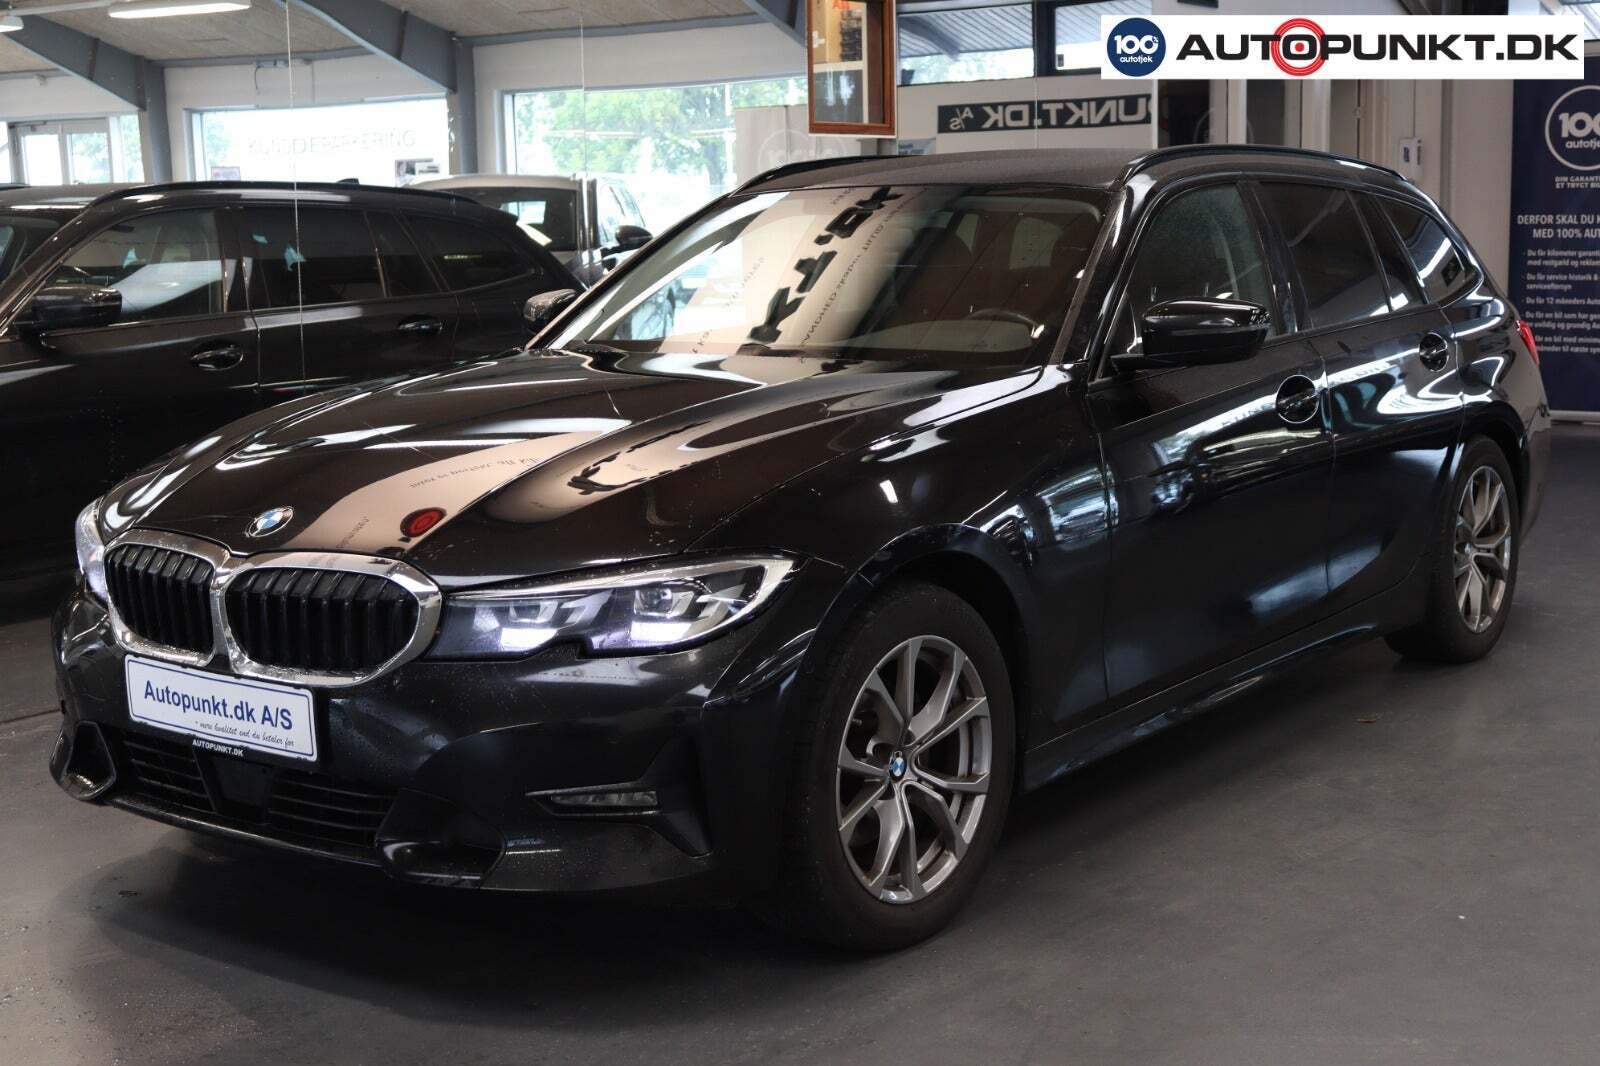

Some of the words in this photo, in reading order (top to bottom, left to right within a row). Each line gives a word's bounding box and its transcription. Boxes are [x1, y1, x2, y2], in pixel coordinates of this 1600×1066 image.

[1517, 214, 1554, 225] DERFOR
[1555, 214, 1579, 225] SKAL
[1580, 214, 1595, 225] DU
[1533, 228, 1555, 239] MED
[1556, 228, 1582, 239] 100%
[144, 680, 256, 723] Autopunkt.dk
[261, 704, 293, 730] A/S
[192, 738, 244, 757] AUTOPUNKT.DK
